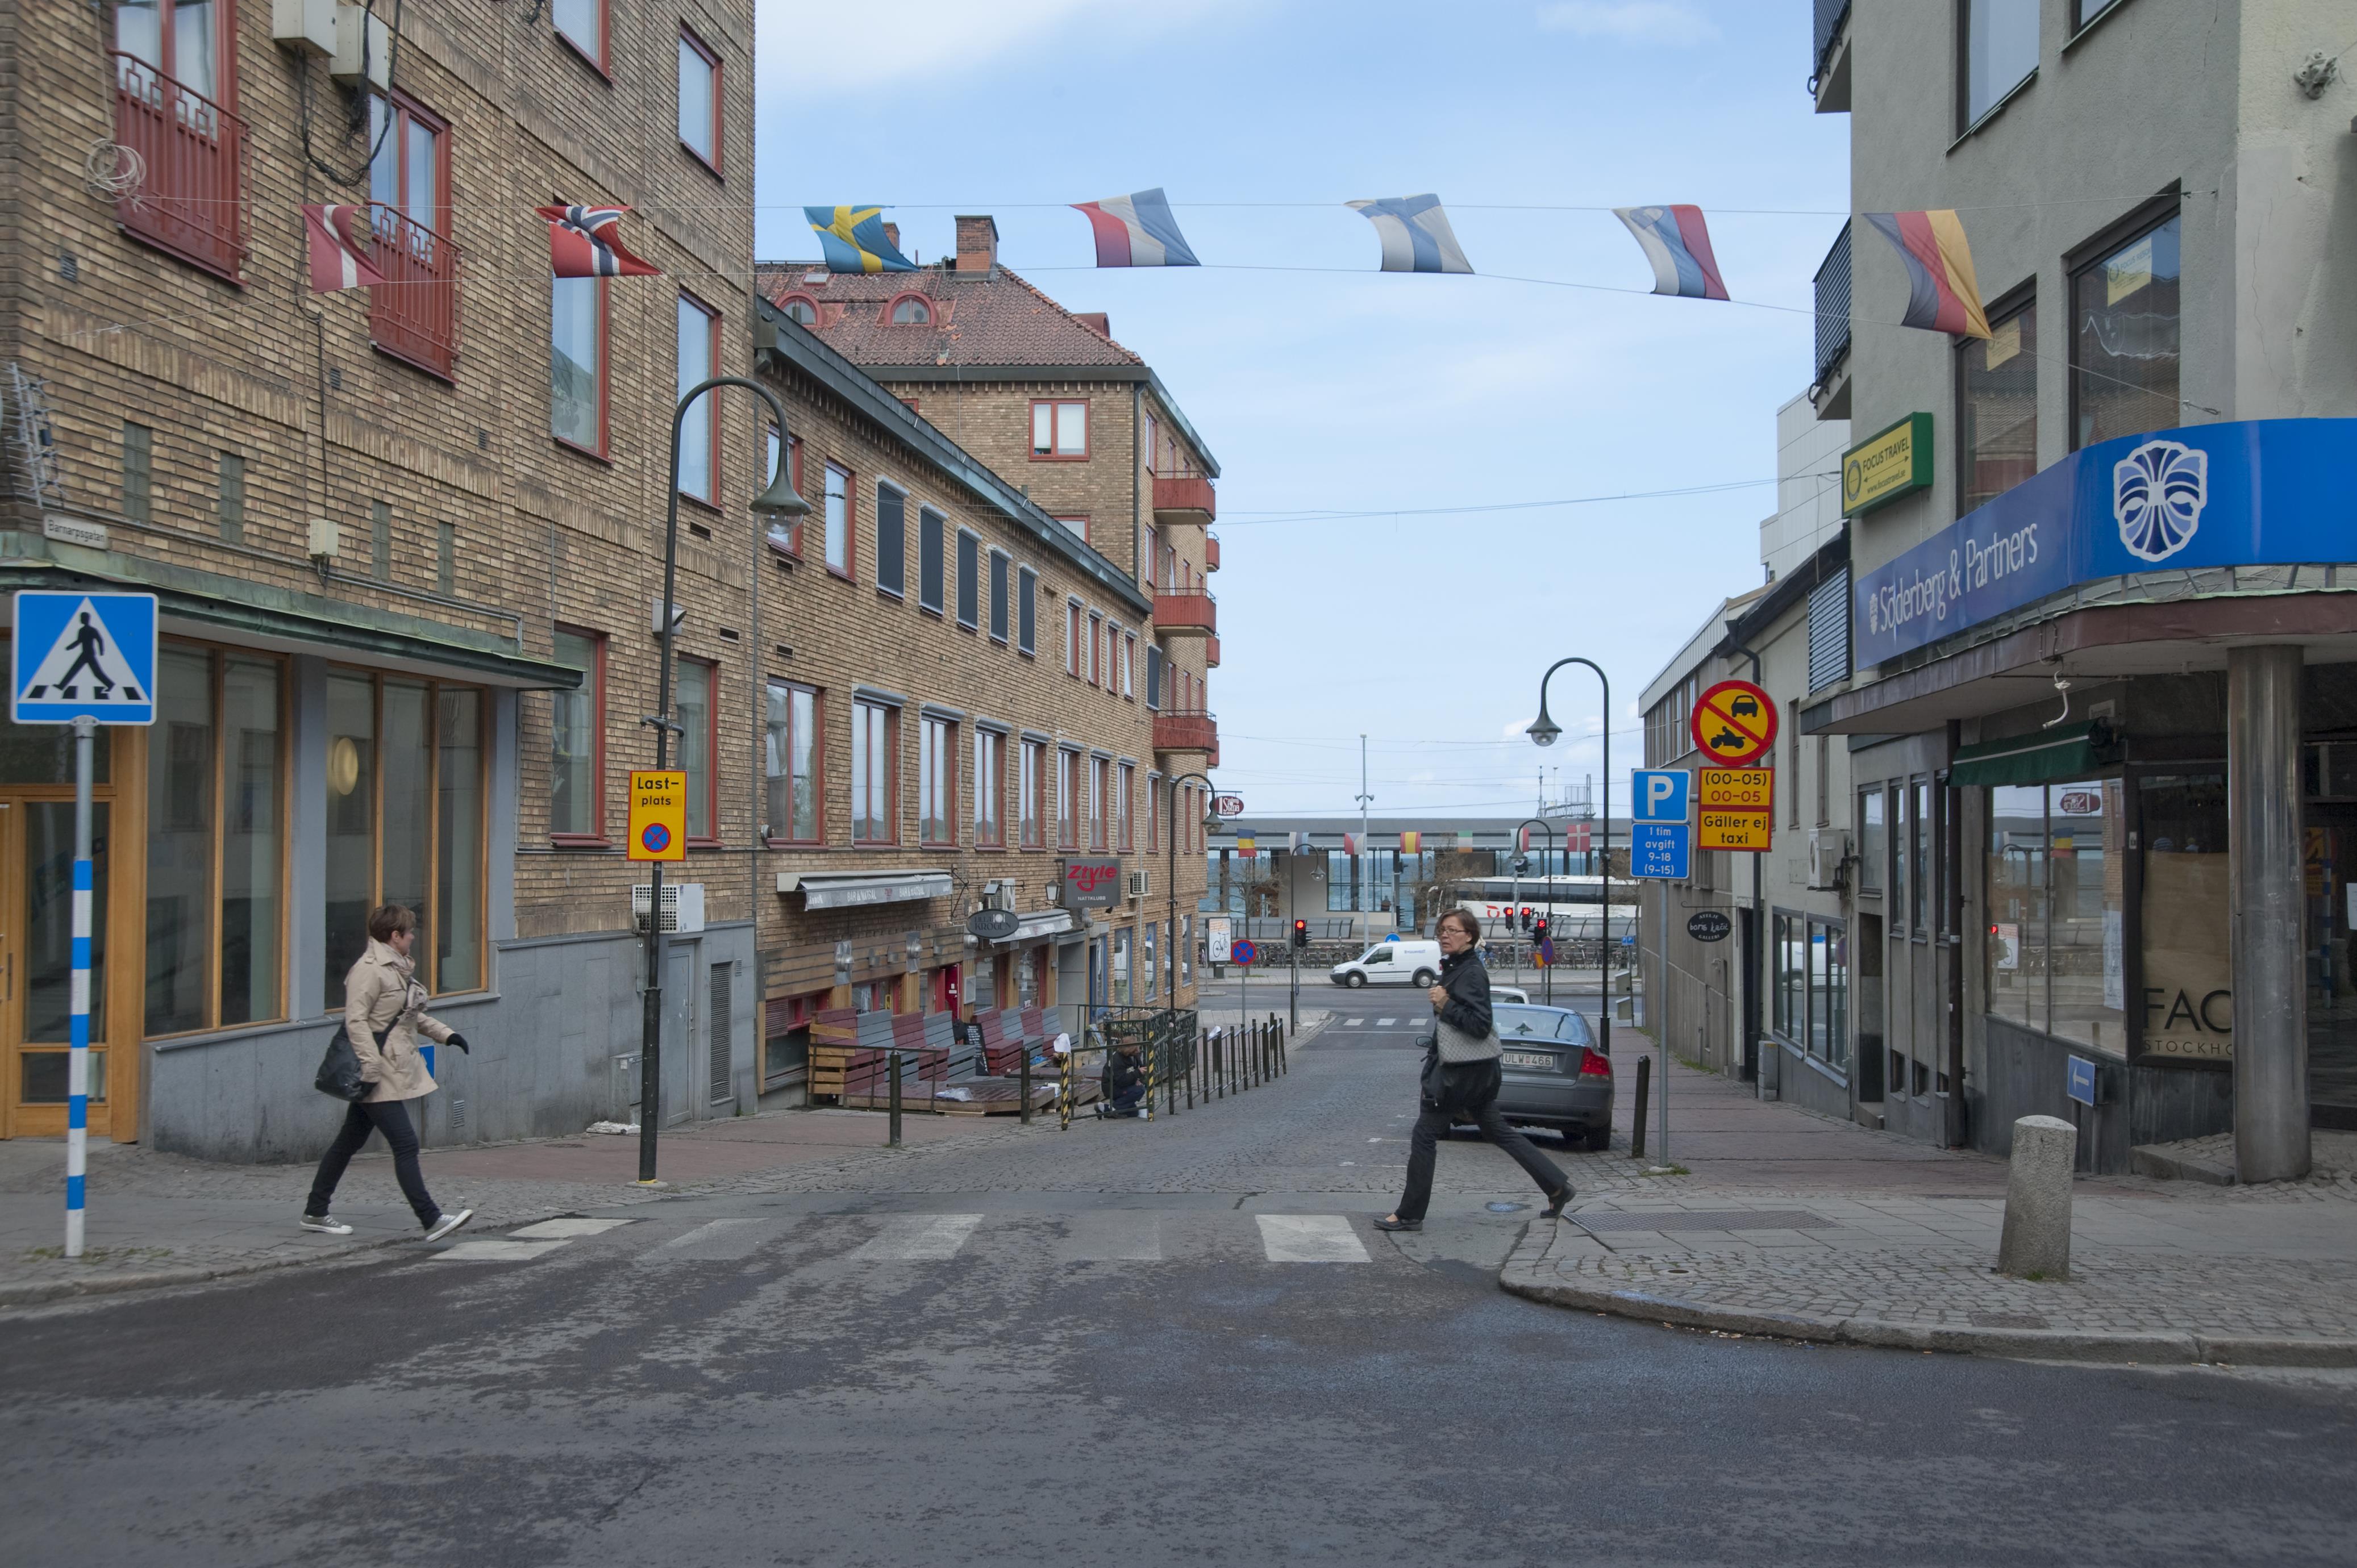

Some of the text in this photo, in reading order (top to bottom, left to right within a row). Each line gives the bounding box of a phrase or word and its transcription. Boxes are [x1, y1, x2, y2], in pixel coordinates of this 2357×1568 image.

[1863, 437, 1910, 473] FOCUS TRAVEL
[1867, 469, 1906, 494] www.focustravel.se
[48, 519, 105, 542] Barnarpsgatan
[1880, 523, 2038, 632] Söderberg & Partners
[638, 777, 679, 790] Last-
[1706, 772, 1767, 786] (00-05)
[642, 795, 671, 807] plats
[1648, 775, 1674, 816] P
[1711, 790, 1761, 802] 00-05
[1704, 815, 1767, 831] Gäller ej
[1650, 827, 1671, 836] 1 tim
[1721, 832, 1748, 844] taxi
[1645, 840, 1675, 851] avgift
[1648, 852, 1671, 862] 9-18
[1644, 864, 1675, 875] (9-15)
[1067, 865, 1117, 892] Ztyle
[975, 922, 1011, 931] KROGEN
[2144, 987, 2232, 1034] FAC
[2144, 1040, 2233, 1056] STOCKHO
[1505, 1054, 1551, 1066] ULW 466
